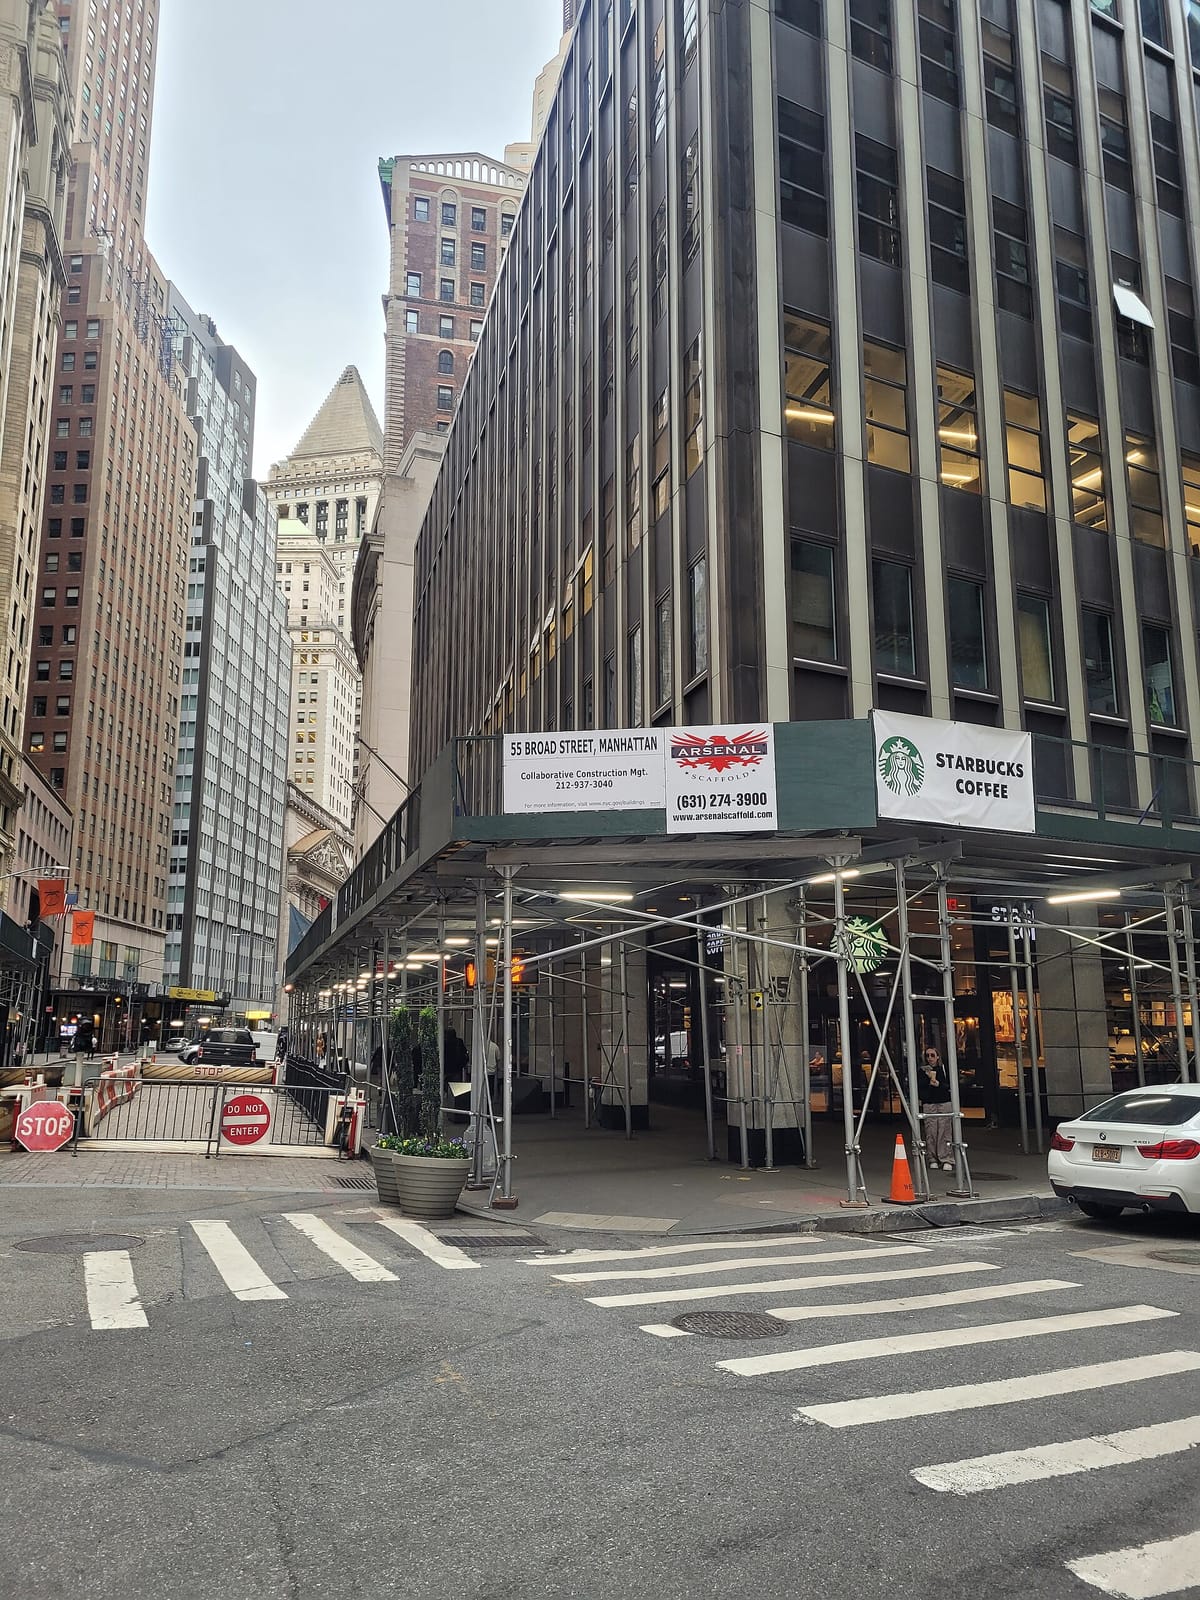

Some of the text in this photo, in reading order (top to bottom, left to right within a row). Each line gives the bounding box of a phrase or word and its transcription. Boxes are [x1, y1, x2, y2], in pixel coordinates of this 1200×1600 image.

[510, 736, 658, 756] 55 BROAD STREET, MANHATTAN
[678, 745, 761, 757] ARSENAL
[935, 752, 1024, 778] STARBUCKS
[520, 768, 648, 780] Collaborative Construction Mgt.
[691, 771, 750, 782] SCAFFOLD
[555, 779, 613, 790] 212-937-3040
[955, 778, 1008, 799] COFFEE
[677, 792, 767, 811] (631) 274-3900
[672, 810, 773, 821] www.arsenalscaffold.com
[194, 1066, 223, 1076] STOP
[227, 1104, 264, 1114] DO NOT
[20, 1115, 71, 1136] STOP
[230, 1126, 259, 1136] ENTER
